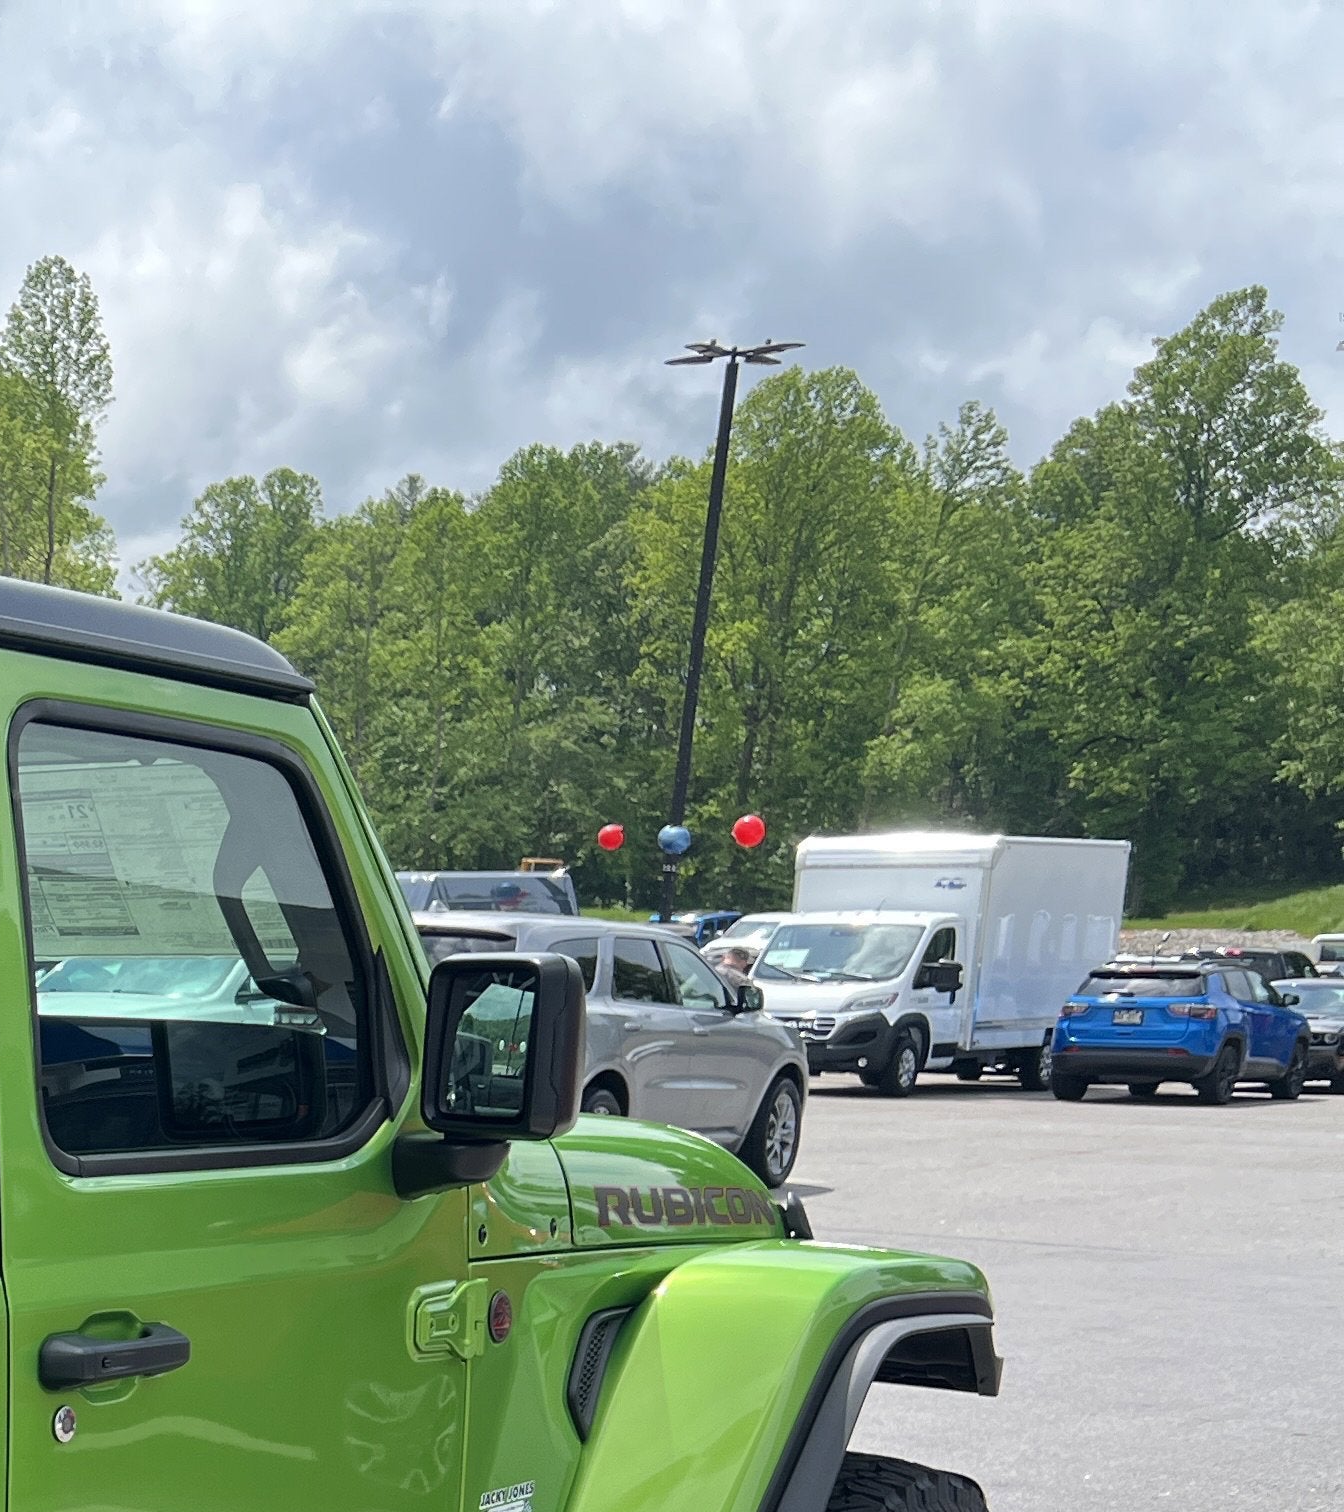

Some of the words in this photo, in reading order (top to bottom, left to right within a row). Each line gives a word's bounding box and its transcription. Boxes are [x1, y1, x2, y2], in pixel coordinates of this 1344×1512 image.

[594, 1186, 776, 1227] RUBICON
[480, 1489, 506, 1507] JACKY
[508, 1482, 534, 1500] JONES
